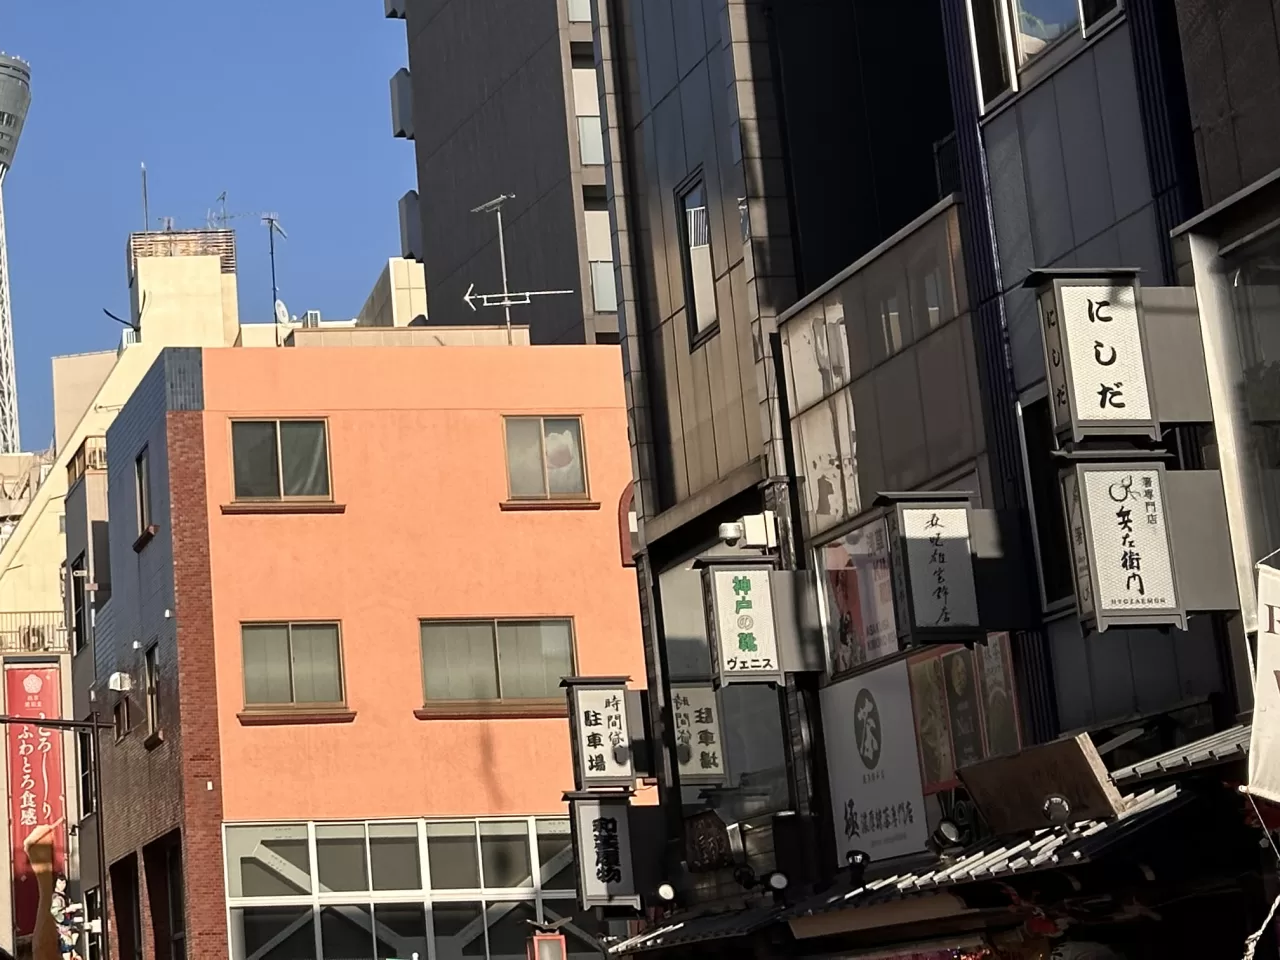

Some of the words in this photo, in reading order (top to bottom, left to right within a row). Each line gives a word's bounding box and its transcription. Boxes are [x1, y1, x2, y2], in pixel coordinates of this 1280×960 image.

[1046, 310, 1067, 408] にしだ
[1086, 298, 1126, 409] にしだ
[732, 575, 758, 652] 神戸の靴
[727, 656, 774, 670] ヴェニス
[18, 725, 38, 826] ふわとろ食感
[584, 710, 606, 772] 駐車場
